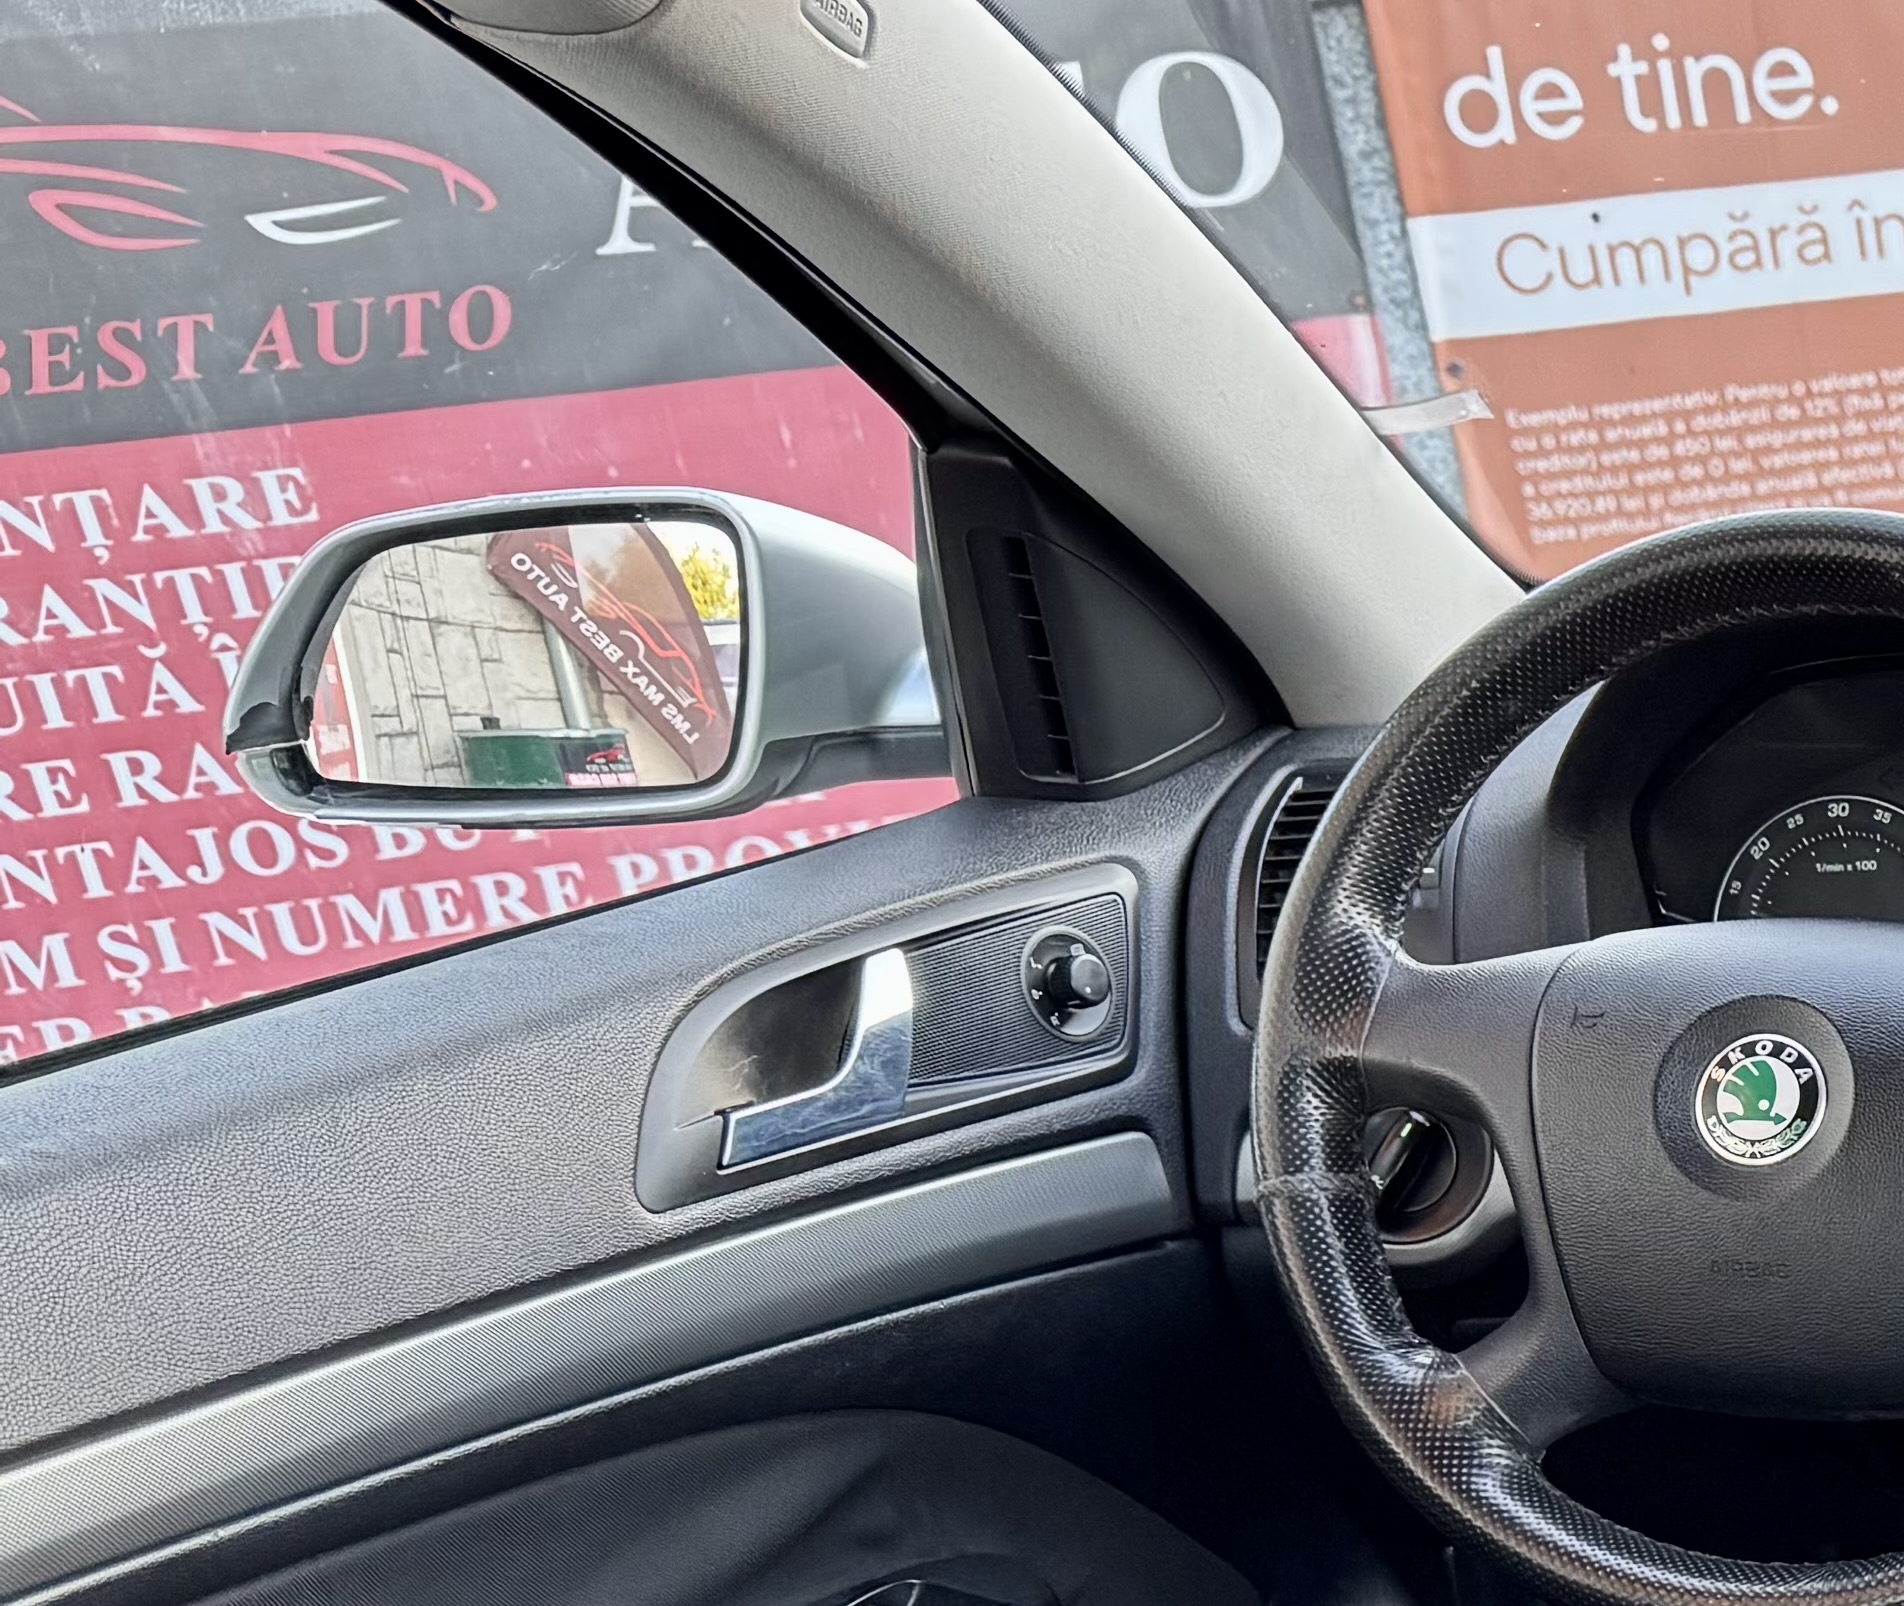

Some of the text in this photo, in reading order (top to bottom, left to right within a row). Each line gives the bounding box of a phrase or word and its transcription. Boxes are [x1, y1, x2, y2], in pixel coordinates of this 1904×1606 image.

[1443, 33, 1840, 148] de tine.
[1495, 204, 1833, 298] Cumpără
[0, 284, 513, 397] EST AUTO
[1786, 813, 1804, 830] 25
[1827, 802, 1850, 818] 30
[1873, 809, 1892, 824] 35
[1750, 836, 1771, 860] 20
[1815, 862, 1844, 873] 1/min
[1855, 860, 1878, 872] 100
[97, 917, 192, 997] ȘI
[199, 861, 600, 967] NUMERE
